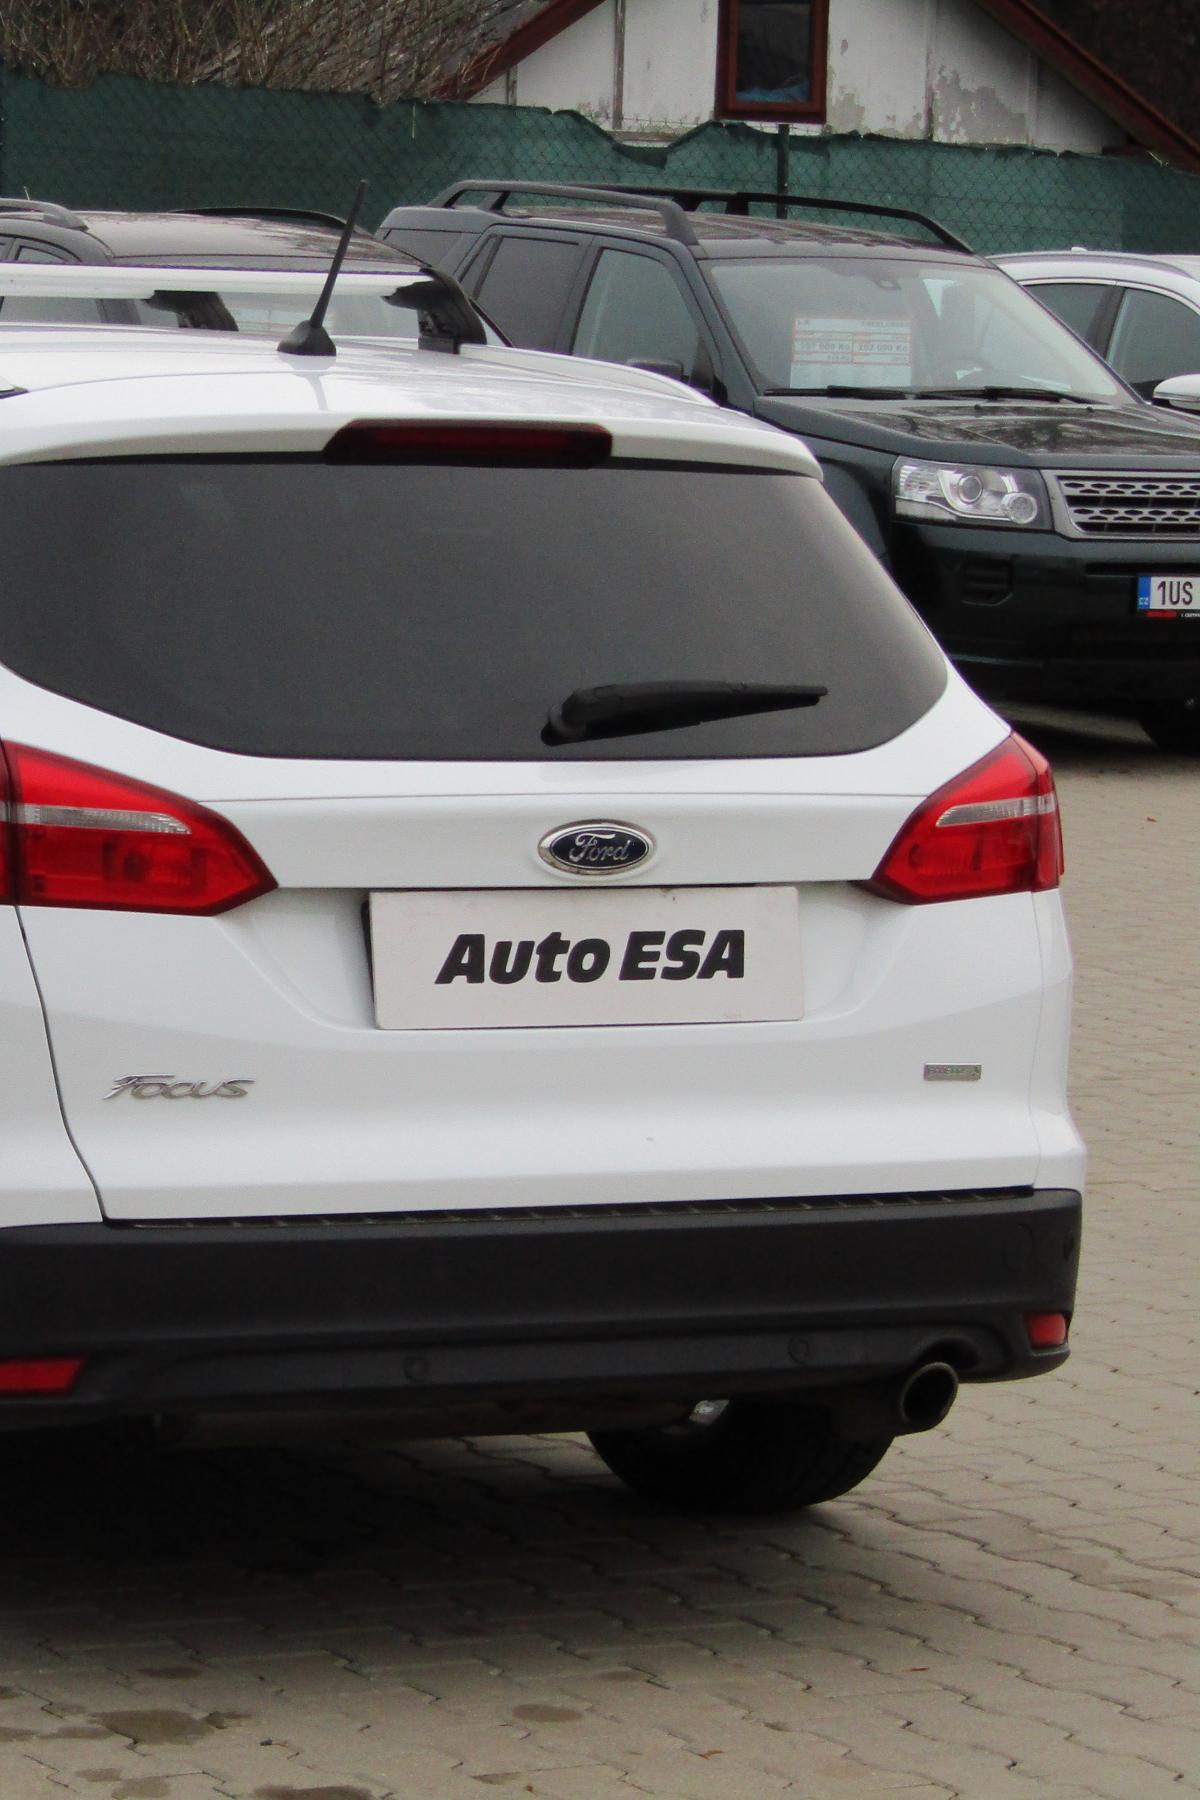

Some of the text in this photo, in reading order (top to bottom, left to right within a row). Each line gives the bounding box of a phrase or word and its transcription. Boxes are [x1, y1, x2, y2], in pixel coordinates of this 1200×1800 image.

[1157, 580, 1193, 606] 1US
[568, 832, 631, 862] Ford
[434, 929, 745, 985] Auto ESA
